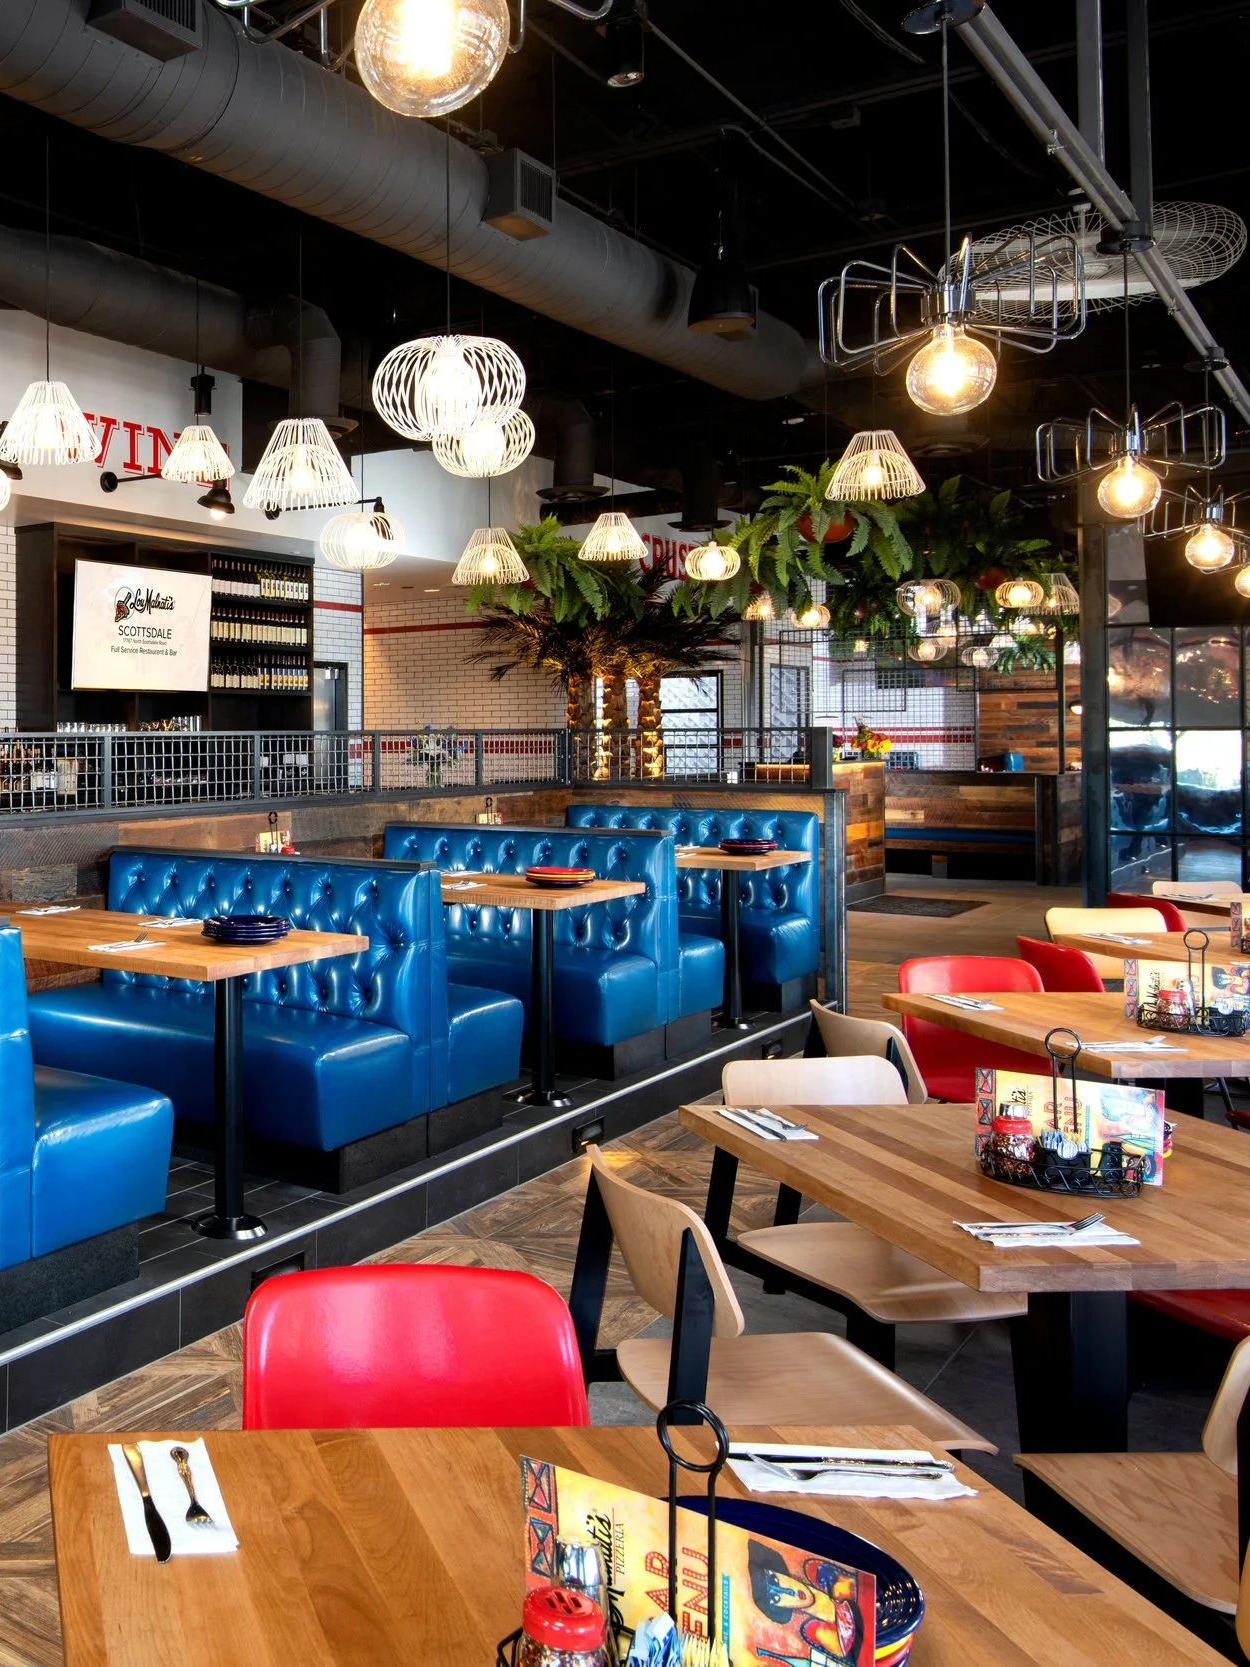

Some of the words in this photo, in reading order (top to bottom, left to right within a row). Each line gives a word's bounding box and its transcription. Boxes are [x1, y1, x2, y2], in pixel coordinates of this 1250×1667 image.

[54, 409, 230, 491] IN
[639, 532, 705, 581] CRUS
[111, 645, 119, 653] Full
[121, 646, 138, 654] Service
[139, 647, 164, 656] Restaurant
[169, 648, 177, 656] Bar
[118, 625, 172, 639] SCOTTSDALE
[615, 1522, 625, 1575] PIZZERIA
[644, 1551, 677, 1620] AR
[682, 1547, 710, 1640] ENU
